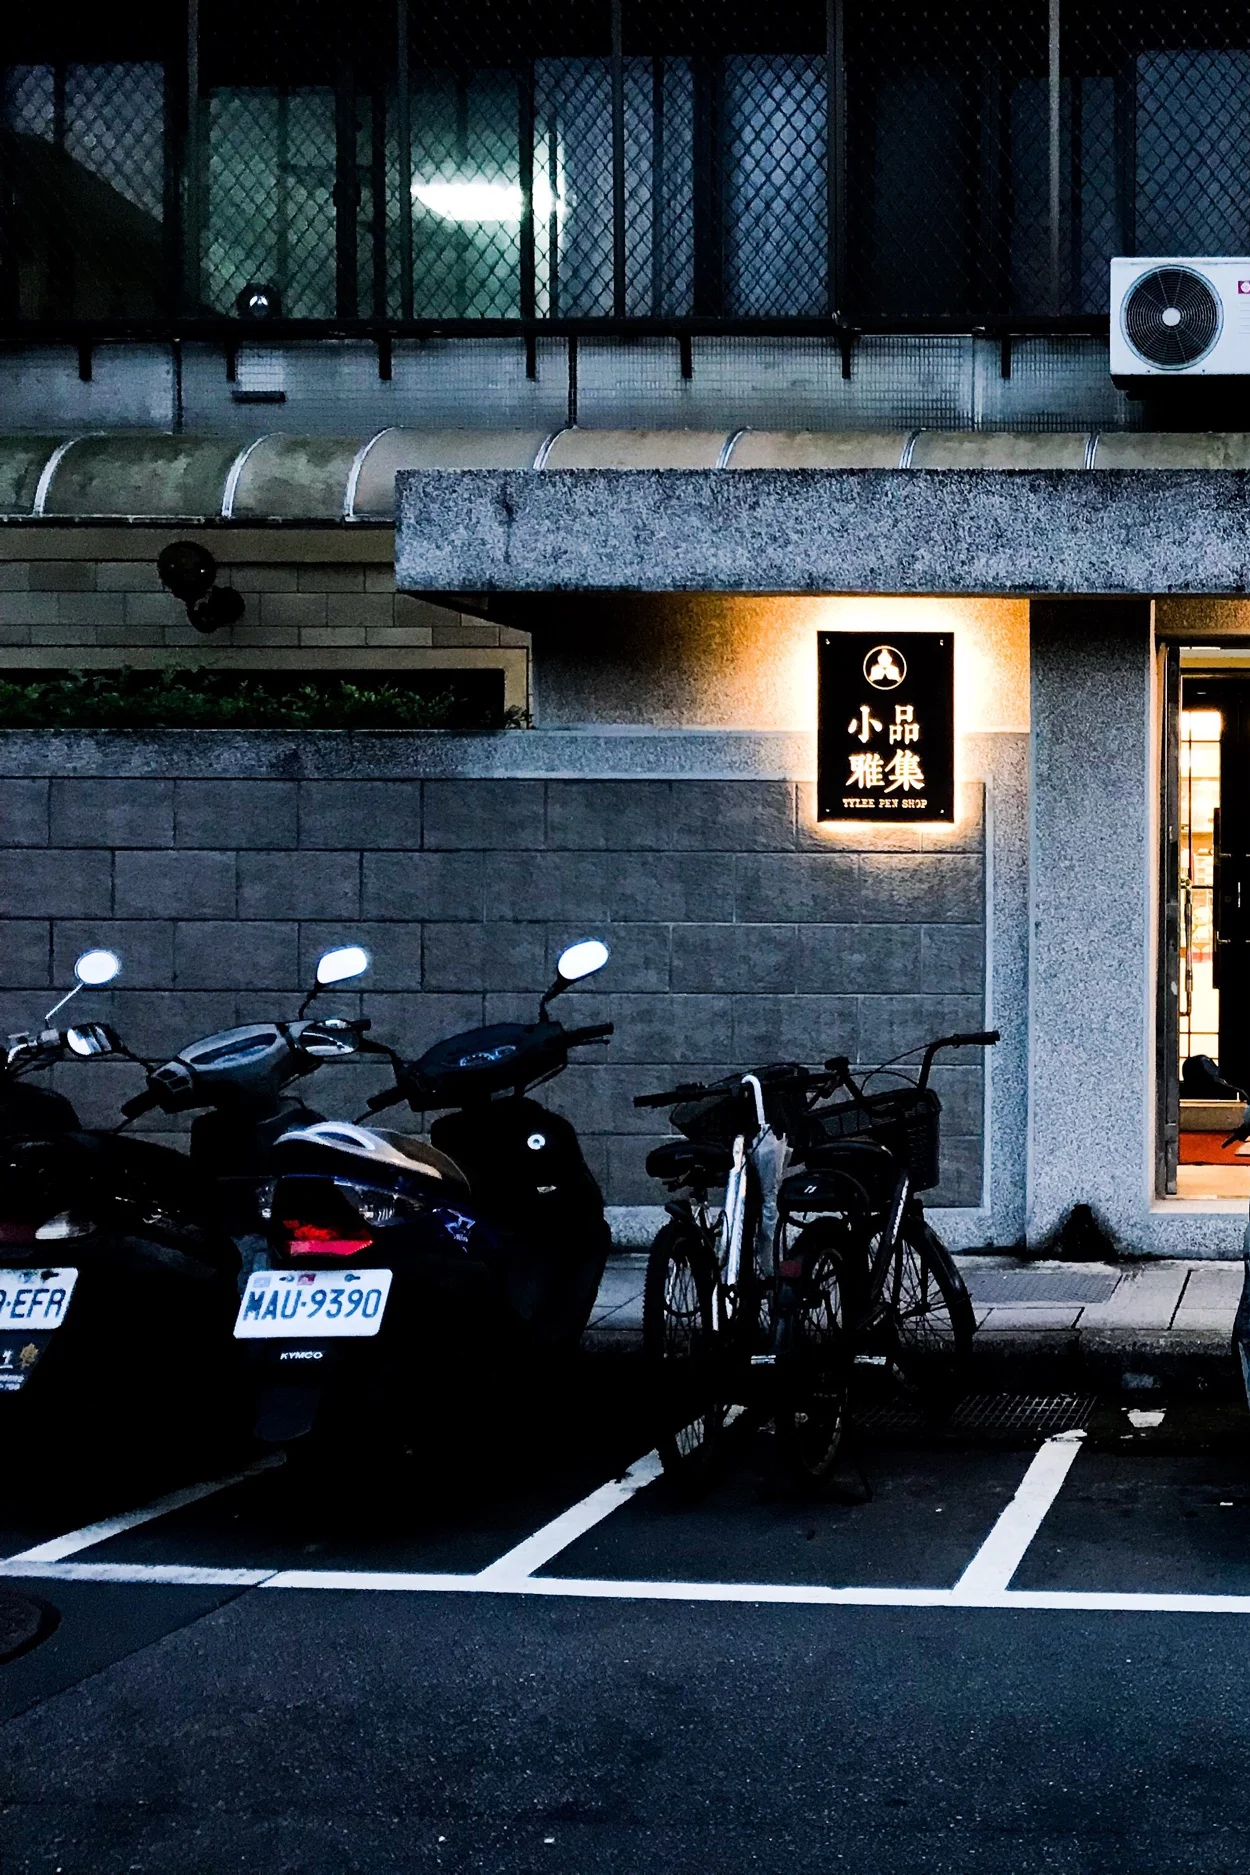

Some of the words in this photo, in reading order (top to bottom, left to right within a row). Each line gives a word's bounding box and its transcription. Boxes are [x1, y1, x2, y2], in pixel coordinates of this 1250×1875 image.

[847, 704, 920, 746] 小品
[845, 748, 926, 793] 雅集
[842, 798, 875, 808] TYLEE
[878, 798, 899, 808] PEN
[901, 798, 928, 809] SHOP
[242, 1288, 382, 1321] MAU-9390
[280, 1350, 323, 1360] KYMCO
